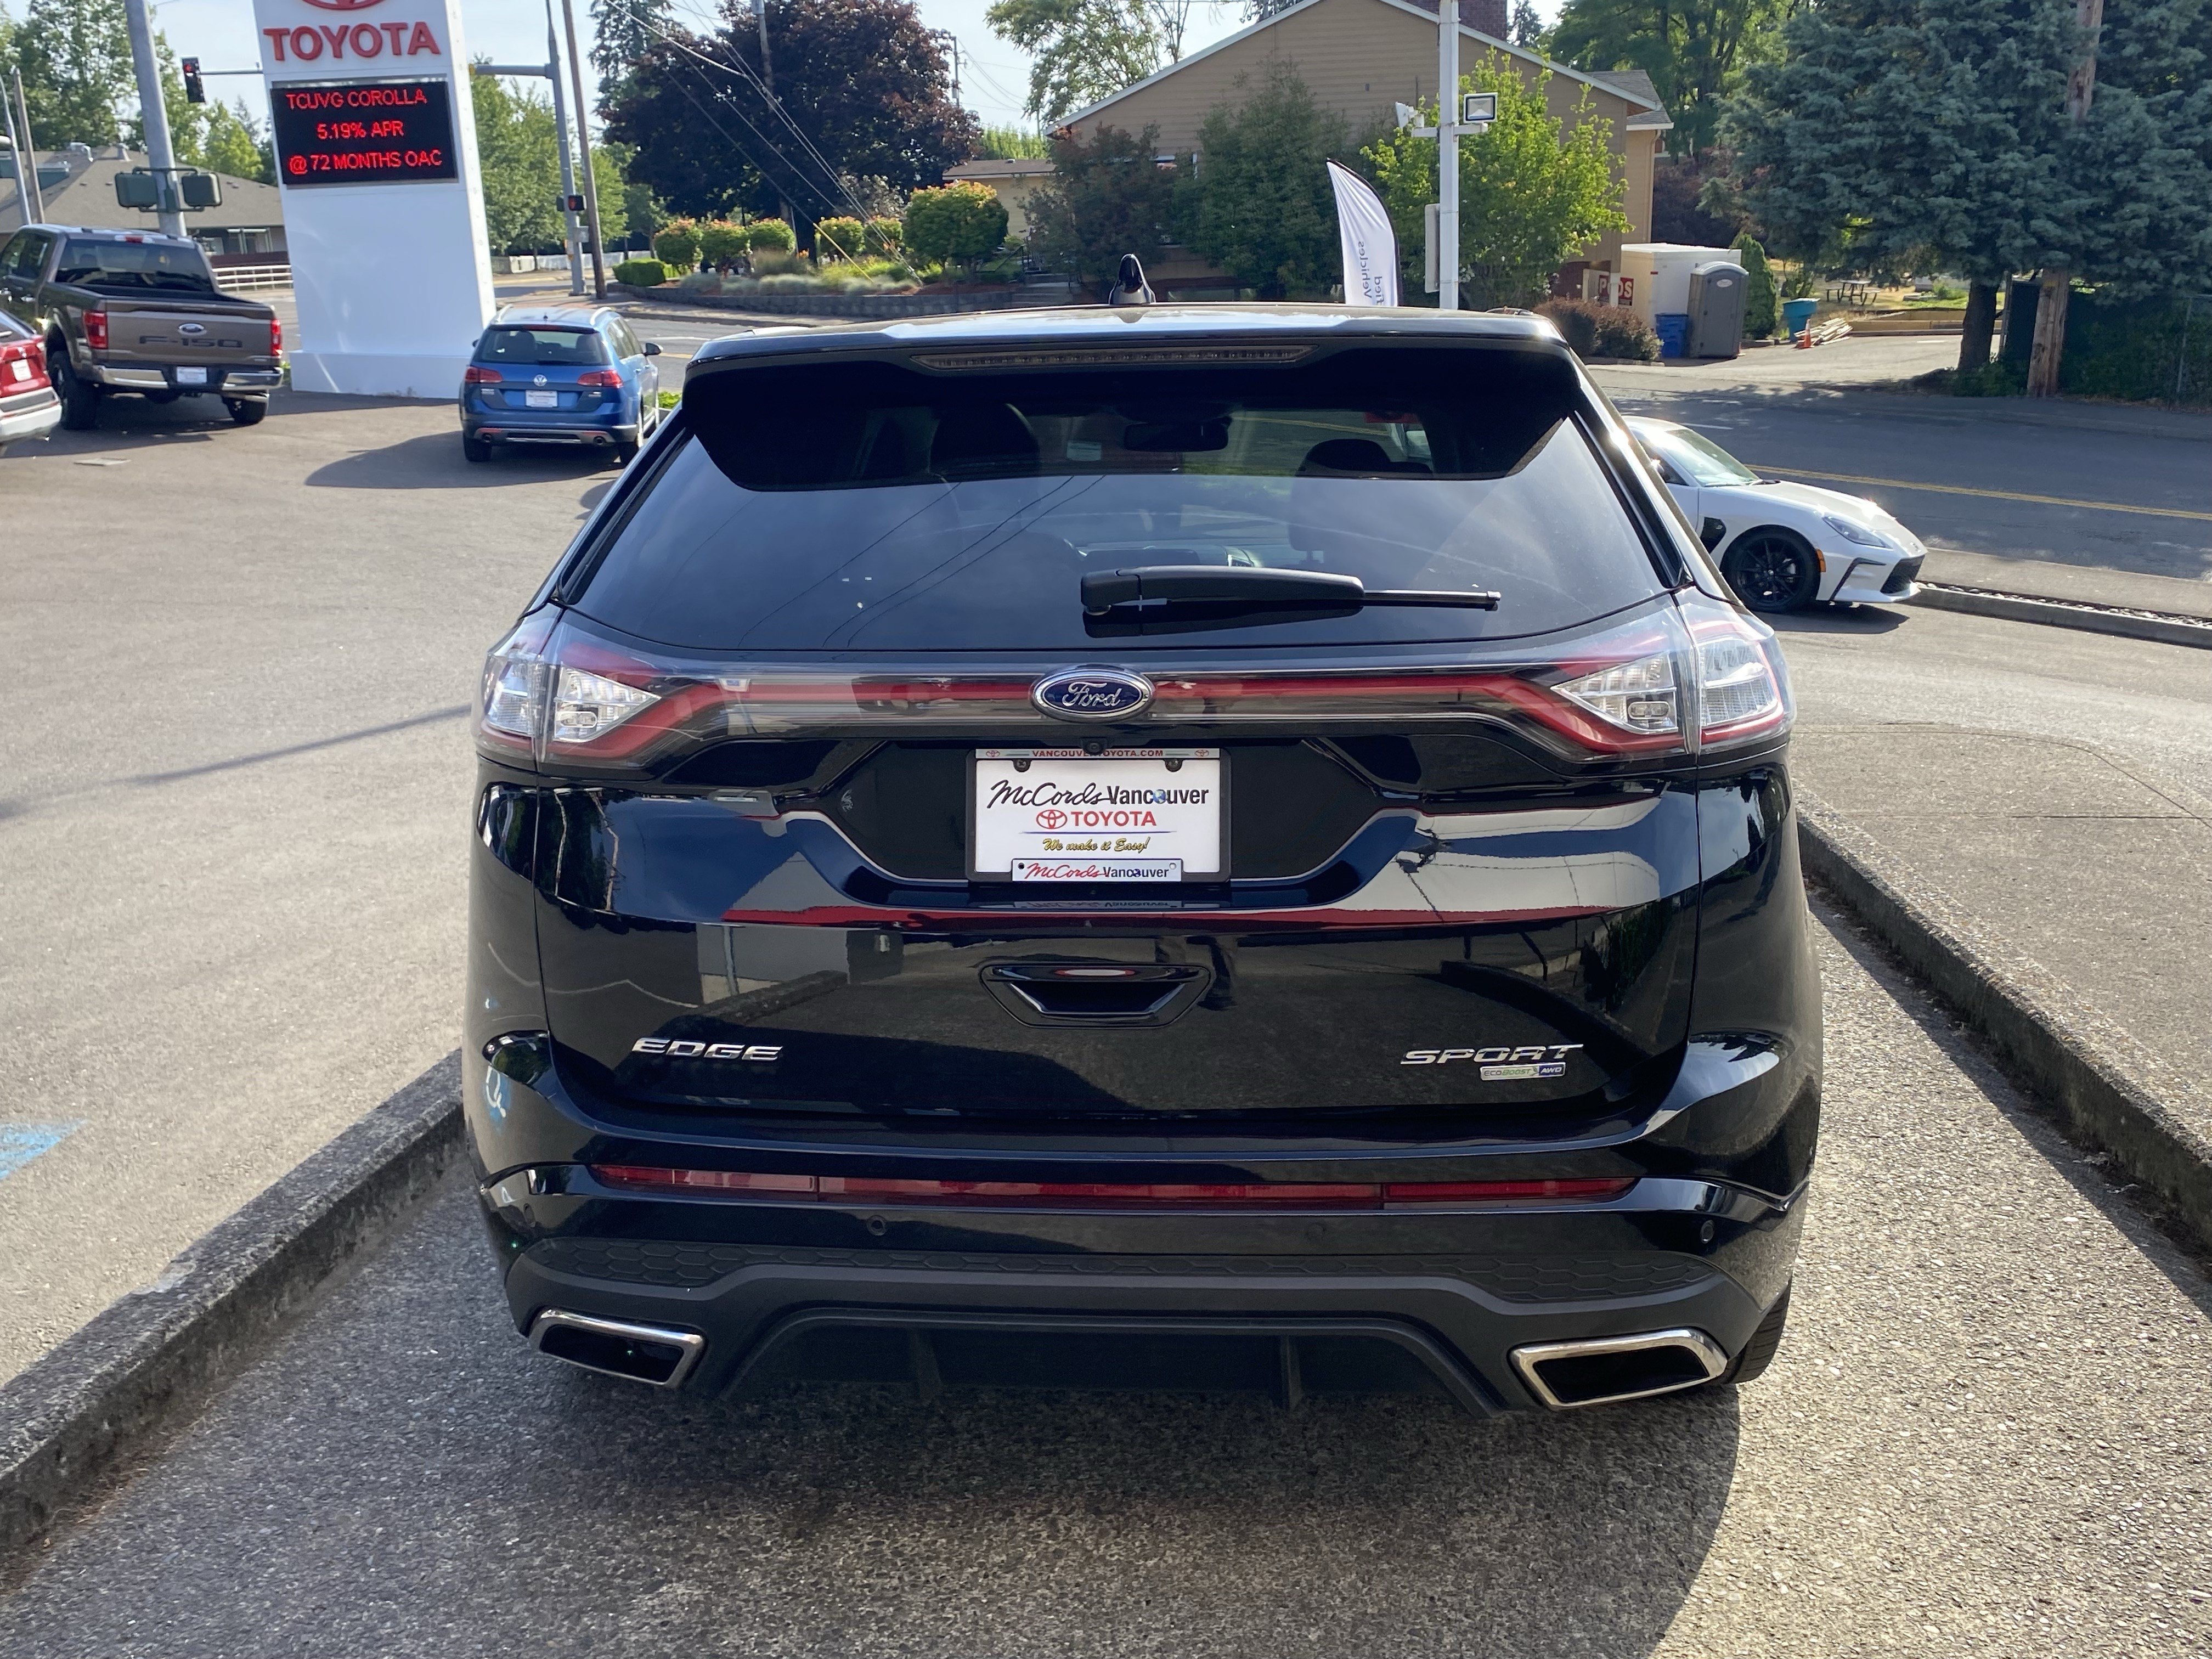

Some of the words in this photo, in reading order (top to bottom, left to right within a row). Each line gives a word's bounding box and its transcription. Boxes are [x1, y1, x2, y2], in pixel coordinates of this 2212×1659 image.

[263, 21, 441, 61] TOYOTA
[285, 91, 343, 110] TCUVG
[347, 88, 428, 107] COROLLA
[317, 122, 366, 139] 5.19%
[371, 120, 404, 137] APR
[289, 155, 308, 175] @
[310, 154, 331, 171] 72
[334, 150, 402, 170] MONTHS
[404, 149, 443, 167] OAC
[139, 335, 243, 348] F-150
[1062, 681, 1123, 707] Ford
[987, 779, 1109, 809] McCords
[1107, 786, 1209, 805] Vancouver
[1071, 811, 1157, 827] TOYOTA
[1042, 838, 1063, 851] We
[1065, 839, 1098, 851] make
[1101, 838, 1111, 851] it
[1114, 837, 1151, 853] Easy!
[1024, 862, 1106, 879] McCords
[632, 1037, 783, 1061] EDGE
[1401, 1043, 1584, 1065] SPORT
